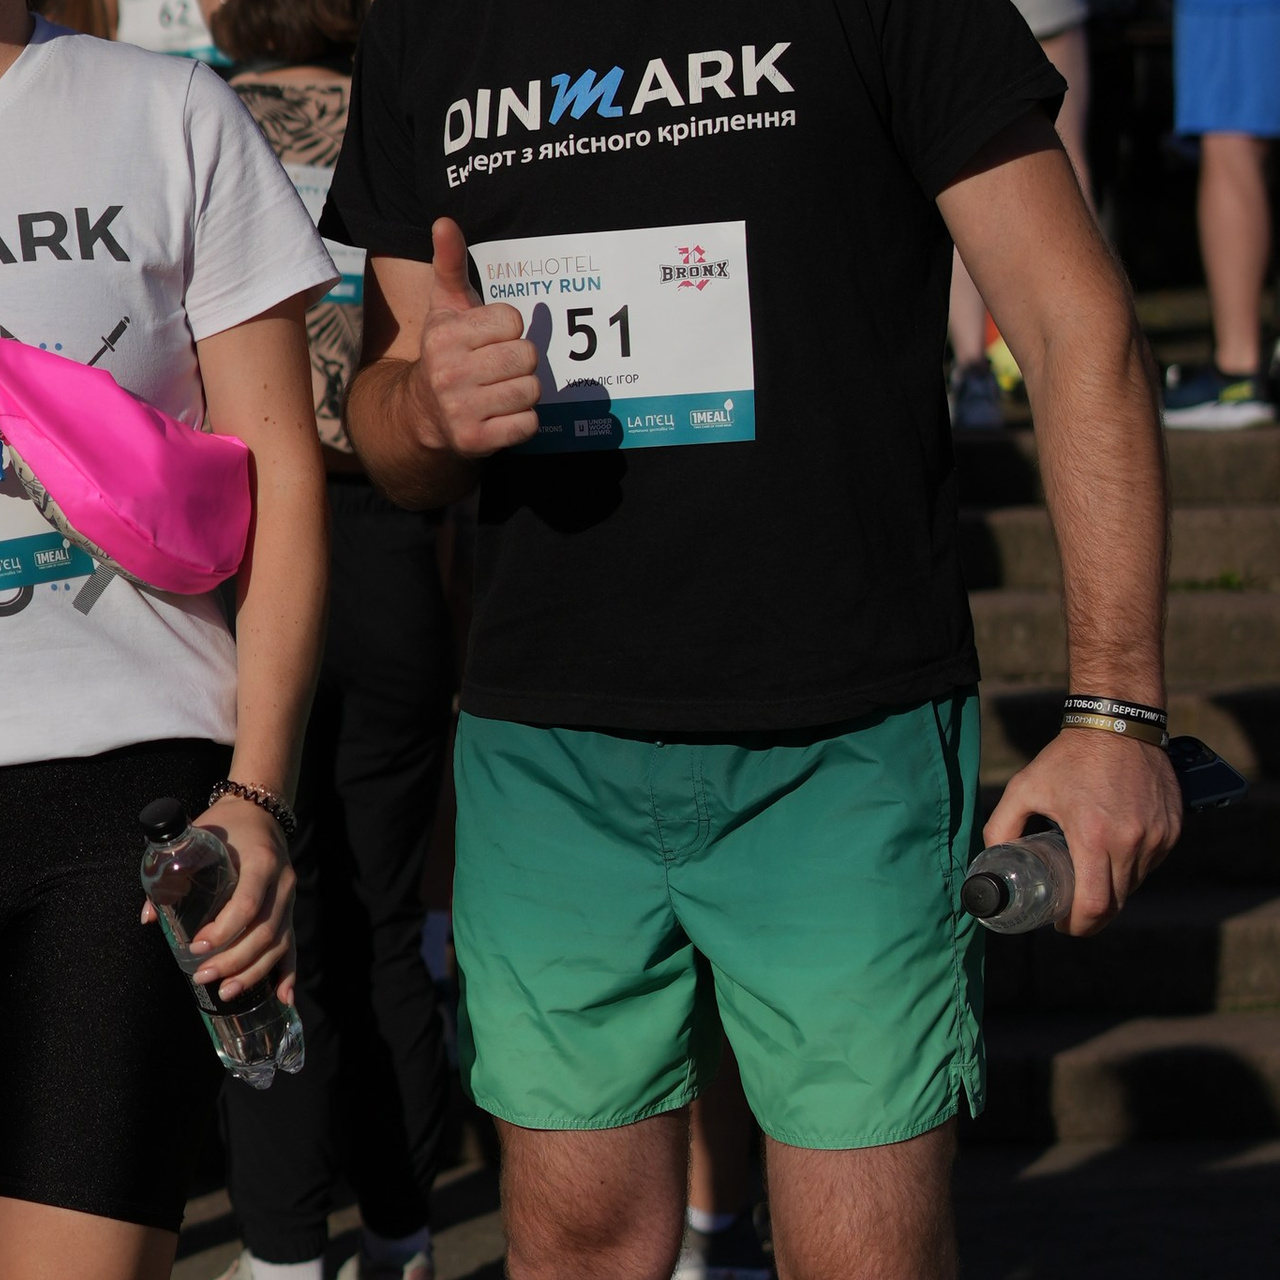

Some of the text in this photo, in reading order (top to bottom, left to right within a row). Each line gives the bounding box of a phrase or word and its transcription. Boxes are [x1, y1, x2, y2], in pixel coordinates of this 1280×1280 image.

[443, 41, 795, 156] DINMARK
[520, 149, 534, 164] з
[537, 127, 651, 161] якісного
[657, 109, 797, 146] кріплення
[486, 254, 601, 280] BANKHOTEL
[661, 262, 729, 282] BRONX
[489, 276, 602, 299] CHARITY RUN
[566, 304, 631, 362] 51
[616, 373, 639, 386] ІГОР
[537, 425, 563, 433] ATRONS
[1111, 704, 1160, 722] БЕРЕГТИМУ
